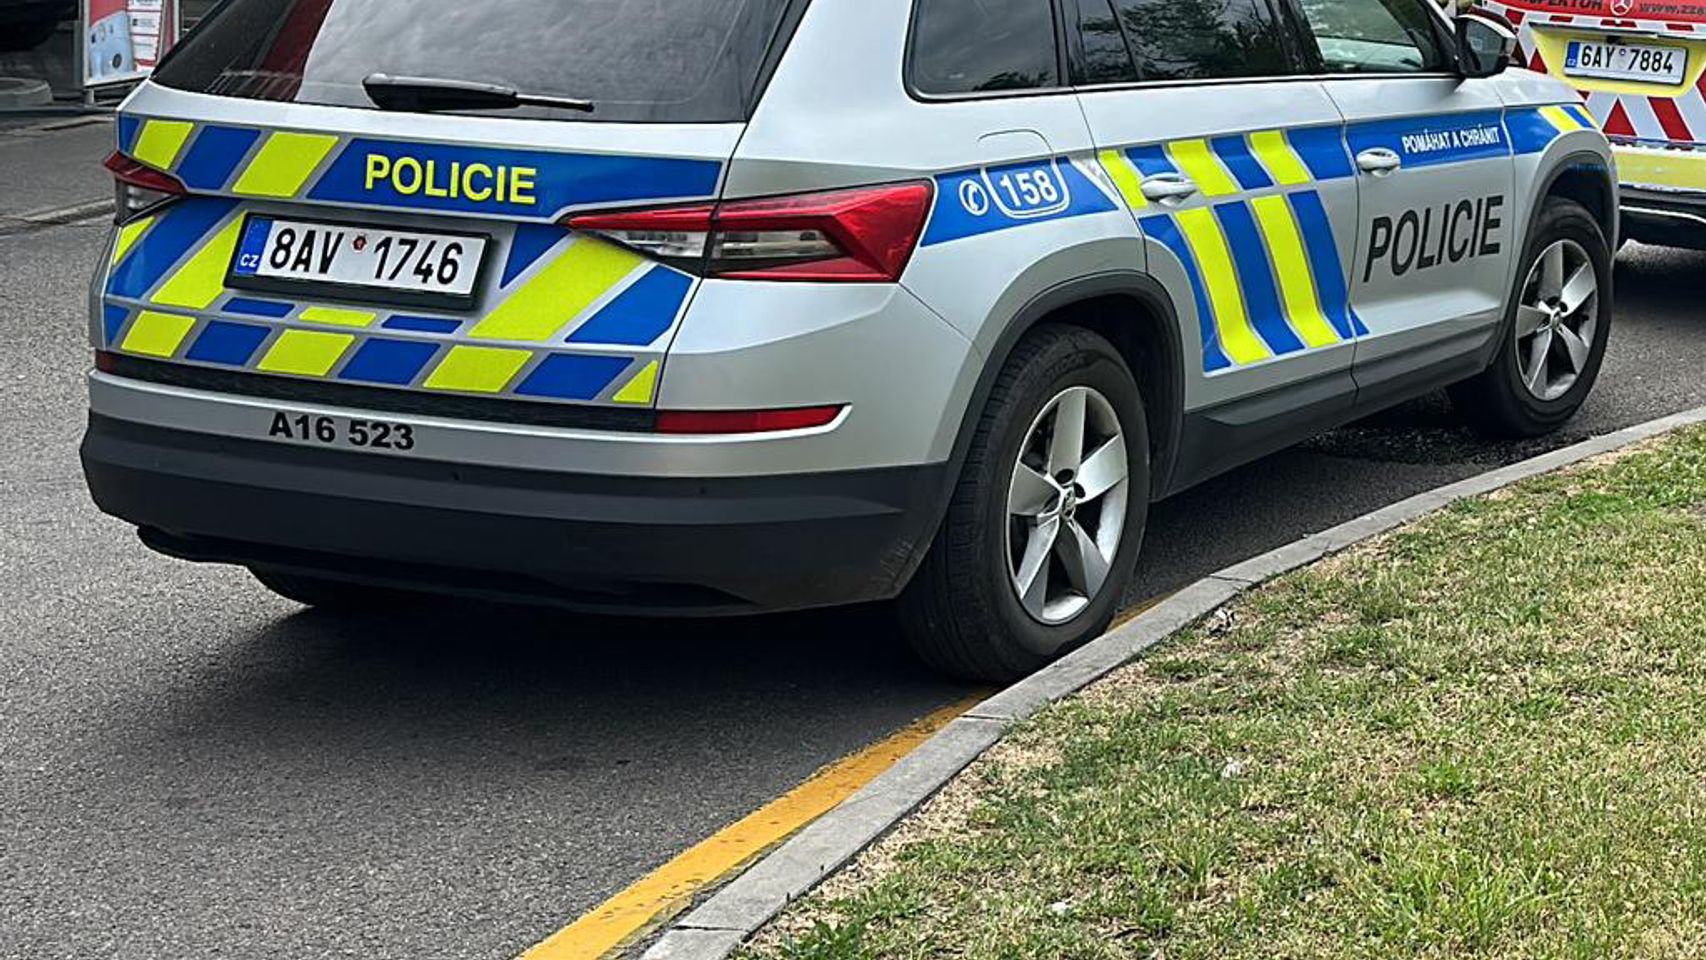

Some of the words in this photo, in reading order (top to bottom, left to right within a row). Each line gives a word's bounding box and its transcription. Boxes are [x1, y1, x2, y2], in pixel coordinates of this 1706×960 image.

[1581, 45, 1615, 68] 6AY
[1628, 48, 1673, 74] 7884
[1401, 128, 1451, 154] POMÁHAT
[1452, 131, 1460, 148] A
[1460, 123, 1500, 147] CHRÁNIT
[364, 153, 537, 205] POLICIE
[1000, 169, 1058, 207] 158
[269, 227, 344, 274] 8AV
[373, 236, 464, 285] 1746
[1363, 194, 1504, 283] POLICIE
[240, 253, 259, 268] CZ
[269, 411, 336, 443] A16
[348, 419, 415, 450] 523
